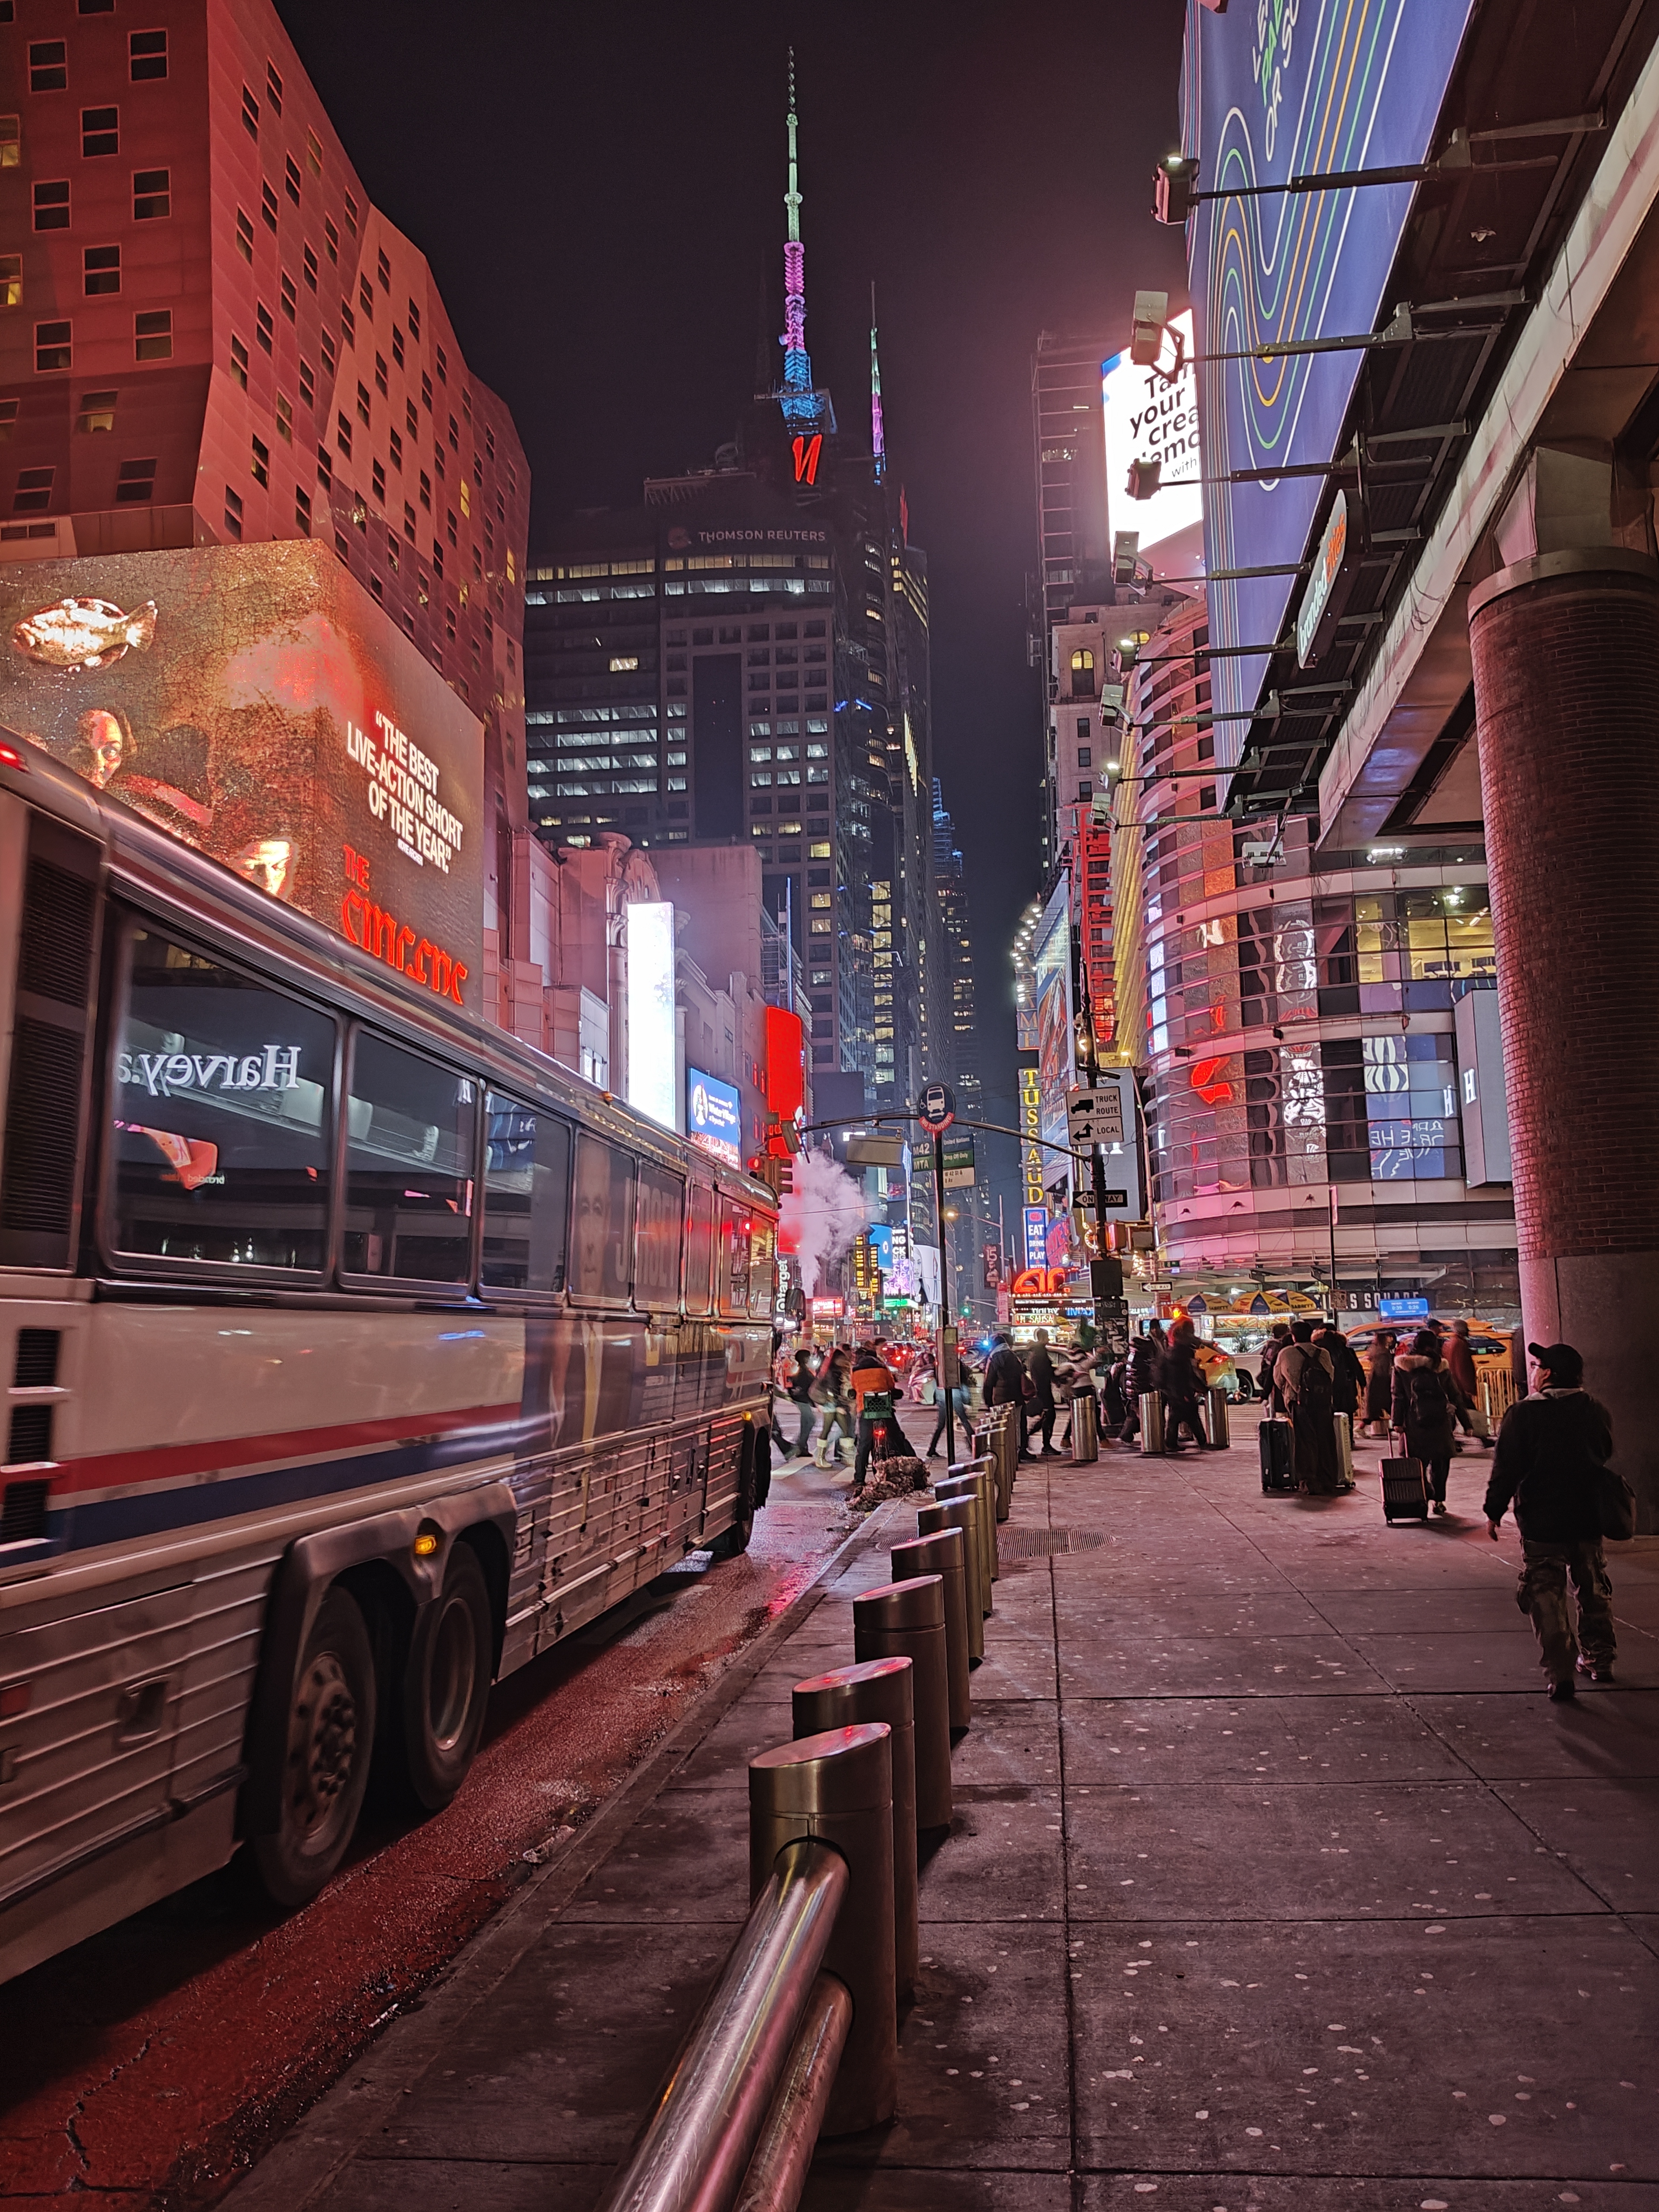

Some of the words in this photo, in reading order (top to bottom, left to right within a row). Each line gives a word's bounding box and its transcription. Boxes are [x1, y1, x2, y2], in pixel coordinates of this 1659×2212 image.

[1130, 387, 1185, 440] your
[1172, 457, 1197, 478] with
[699, 530, 763, 542] THOMSON
[767, 530, 826, 542] REUTERS
[409, 742, 440, 795] BEST
[347, 720, 424, 819] LIVE-ACTION
[426, 794, 463, 851] SHORT
[369, 780, 388, 820] OF
[389, 796, 414, 845] THE
[343, 844, 369, 891] THE
[1095, 1095, 1117, 1103] TRUCK
[1096, 1107, 1118, 1115] ROUTE
[921, 1117, 928, 1127] NO
[928, 1115, 952, 1131] STANDING
[1097, 1126, 1120, 1134] LOCAL
[913, 1143, 930, 1156] M42
[914, 1159, 929, 1170] MTA
[1028, 1225, 1044, 1236] EAT
[1029, 1251, 1045, 1259] PLAY
[778, 1259, 791, 1299] target
